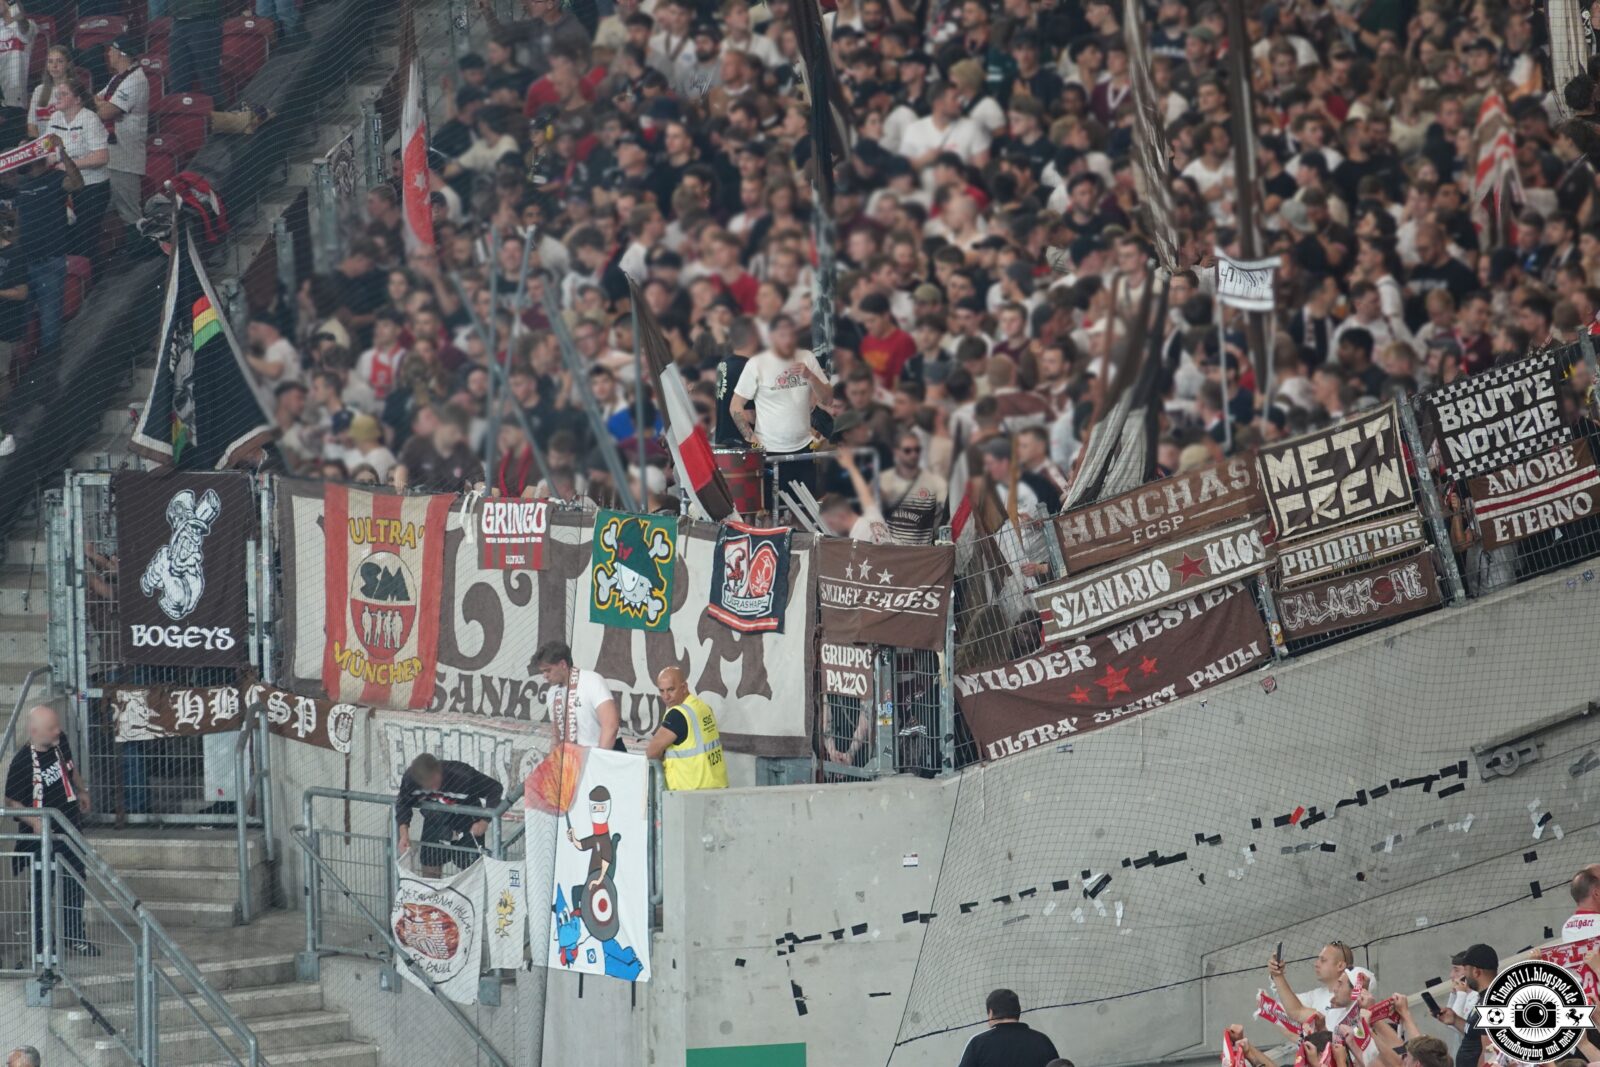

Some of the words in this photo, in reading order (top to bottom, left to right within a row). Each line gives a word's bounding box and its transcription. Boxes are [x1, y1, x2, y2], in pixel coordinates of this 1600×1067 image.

[1437, 370, 1555, 432] BRUTTE
[1264, 413, 1391, 493] METT
[1445, 400, 1560, 462] NOTIZIE
[1486, 445, 1577, 495] AMORE
[481, 502, 547, 534] GRINGO
[1058, 459, 1250, 549] HINCHAS
[1276, 457, 1404, 536] CREW
[1493, 492, 1592, 542] ETERNO
[1131, 515, 1185, 544] FCSP
[1281, 519, 1422, 576] PRIORITAS
[820, 581, 863, 606] SMILEY
[1051, 559, 1171, 629] SZENARIO
[1204, 529, 1266, 575] KAOS
[130, 624, 236, 650] BOGEYS
[826, 668, 868, 697] PAZZO
[953, 644, 1097, 698] WILDER
[1187, 641, 1262, 691] PAULI
